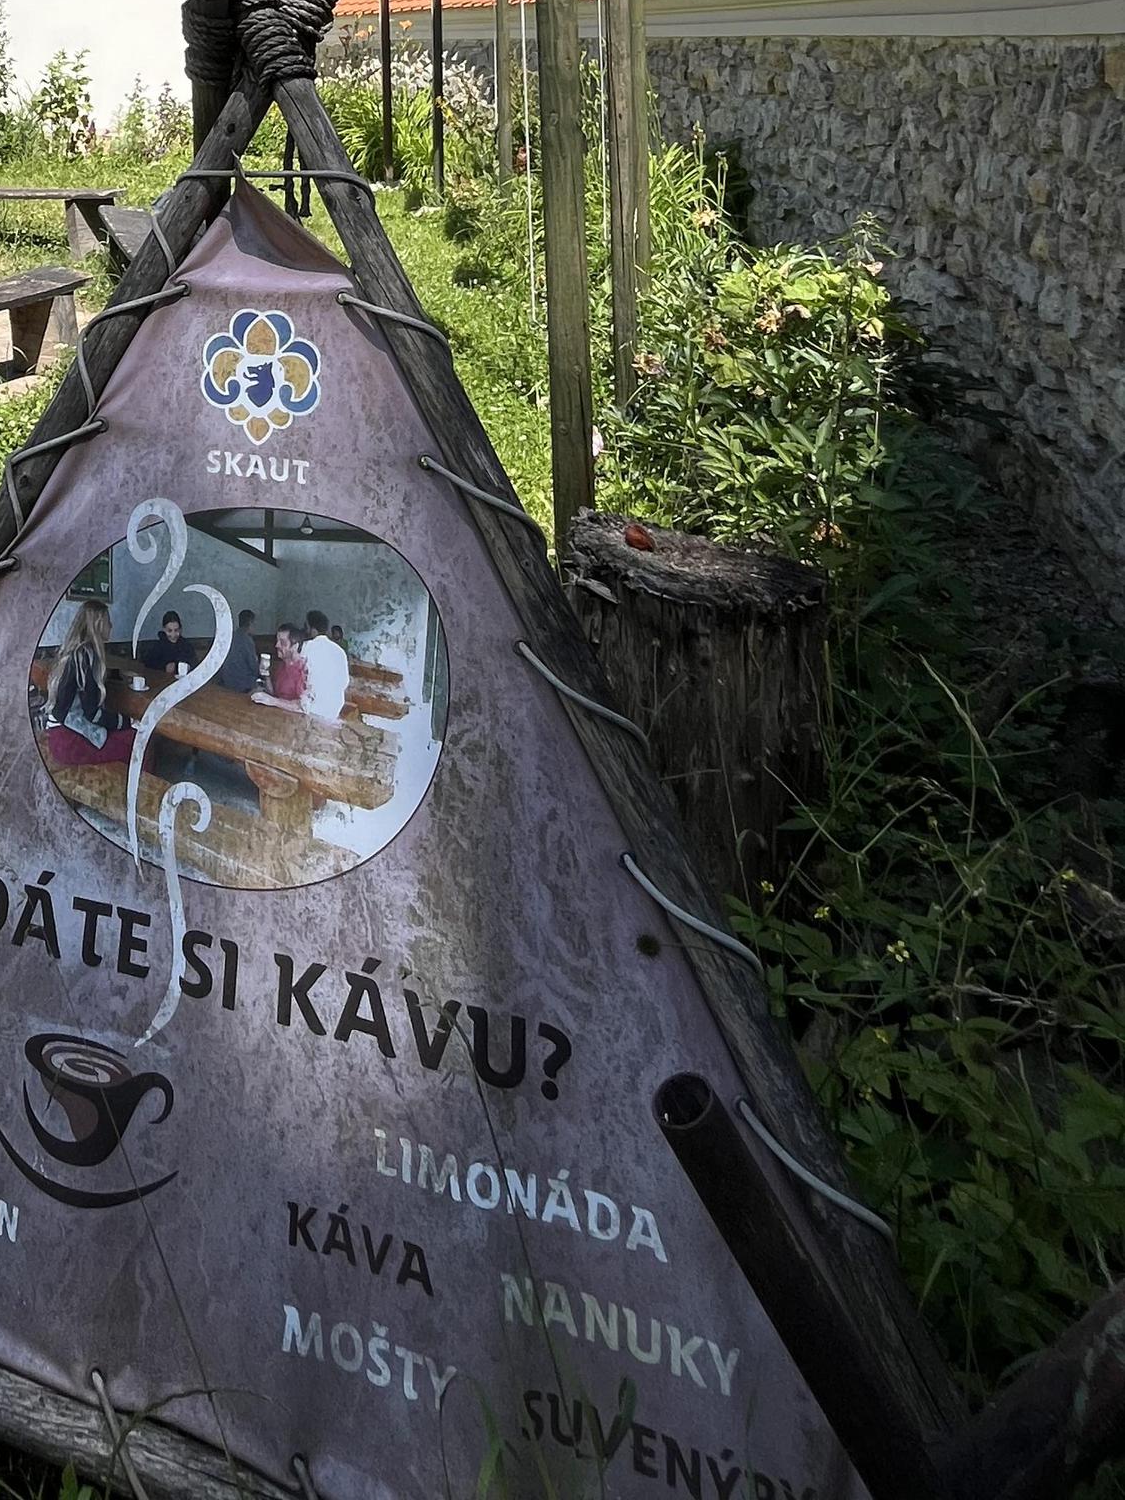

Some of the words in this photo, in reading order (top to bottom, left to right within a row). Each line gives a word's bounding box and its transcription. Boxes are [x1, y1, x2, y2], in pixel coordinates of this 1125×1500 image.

[206, 449, 310, 485] SKAUT
[179, 930, 239, 1011] SI
[274, 953, 573, 1101] KÁVU?
[287, 1201, 435, 1297] KÁVA
[374, 1128, 668, 1263] LIMONÁDA
[281, 1304, 458, 1411] MOŠTY
[500, 1273, 741, 1397] NANUKY
